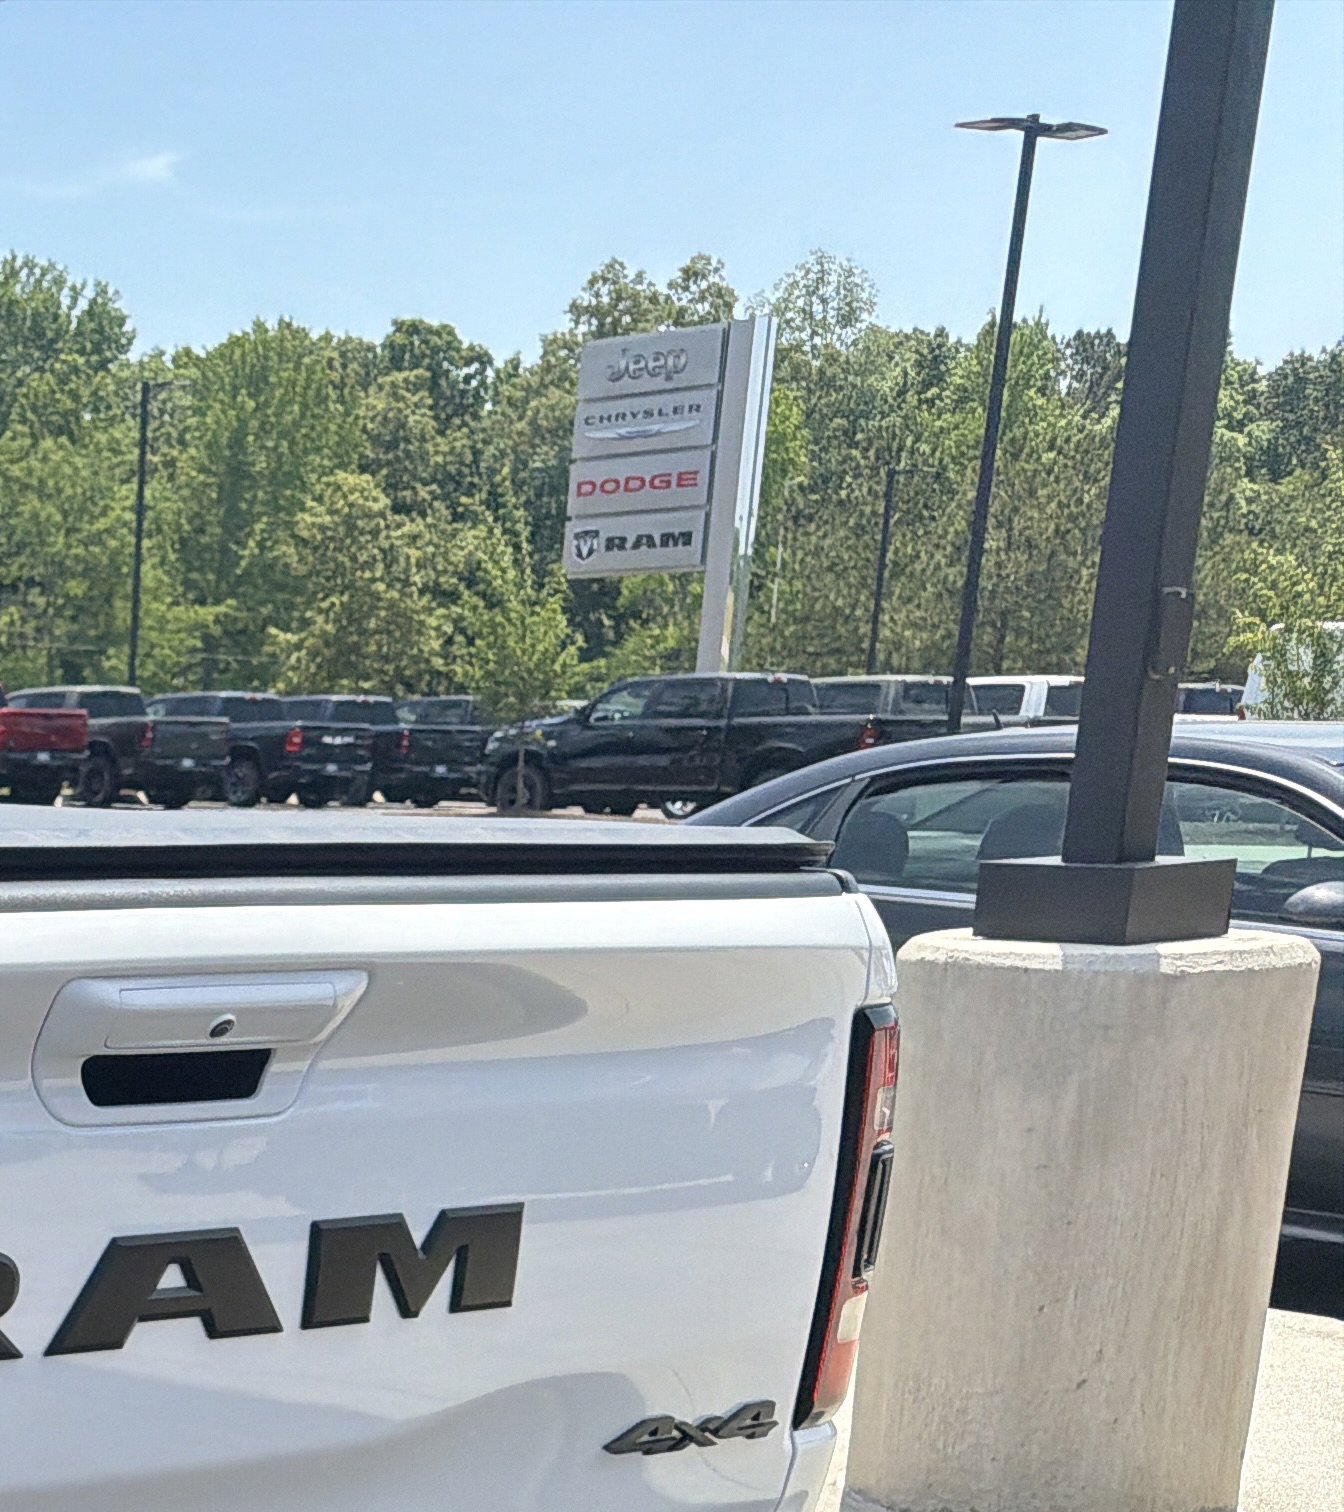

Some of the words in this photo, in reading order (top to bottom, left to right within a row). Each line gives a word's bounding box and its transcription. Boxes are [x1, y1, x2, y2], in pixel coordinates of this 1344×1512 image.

[606, 348, 688, 382] Jeep
[584, 403, 702, 426] CHRYSLER
[576, 471, 700, 497] DODGE
[604, 530, 693, 552] RAM
[602, 1399, 779, 1455] 4x4
